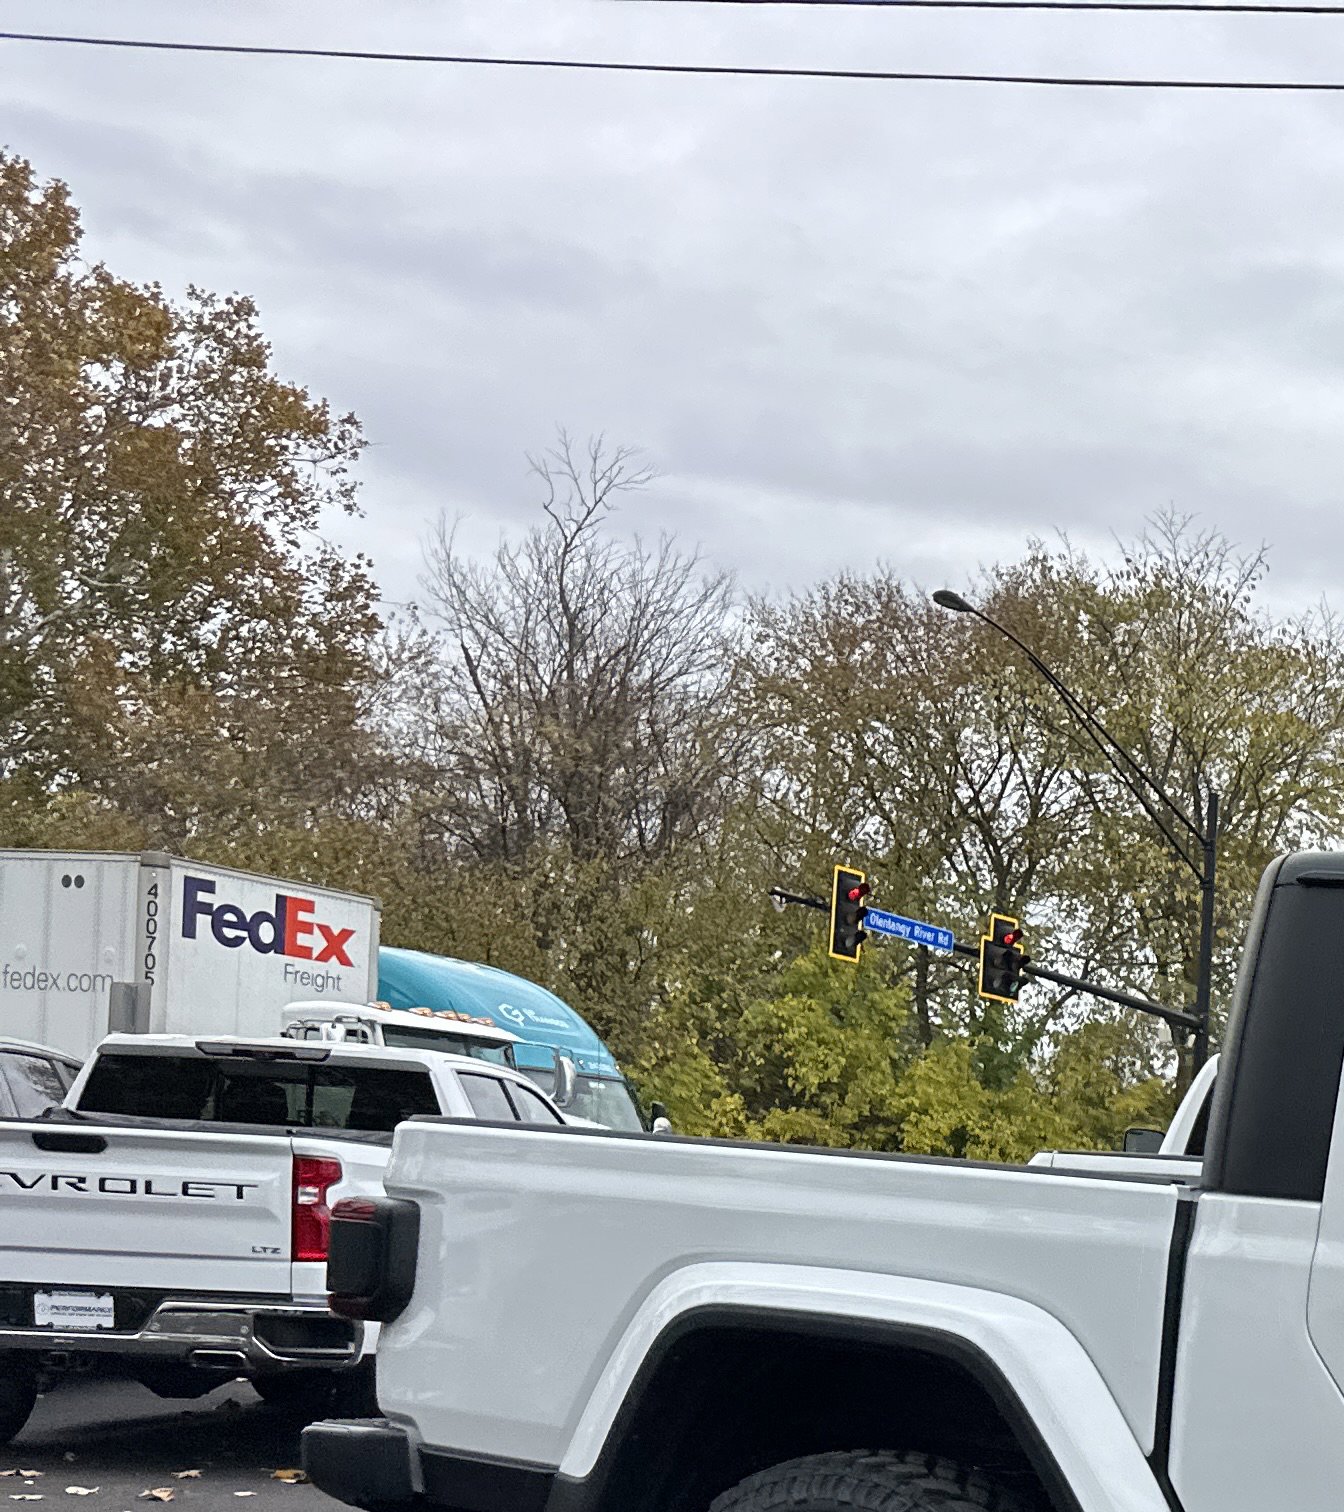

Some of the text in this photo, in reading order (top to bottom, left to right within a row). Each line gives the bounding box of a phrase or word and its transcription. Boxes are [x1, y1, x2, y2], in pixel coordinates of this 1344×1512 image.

[182, 875, 356, 968] FedEx
[914, 925, 935, 942] River
[938, 932, 949, 947] Rd
[3, 964, 113, 992] fedex.com
[283, 963, 342, 993] Freight
[0, 1172, 259, 1200] VROLET
[252, 1246, 281, 1254] LTZ
